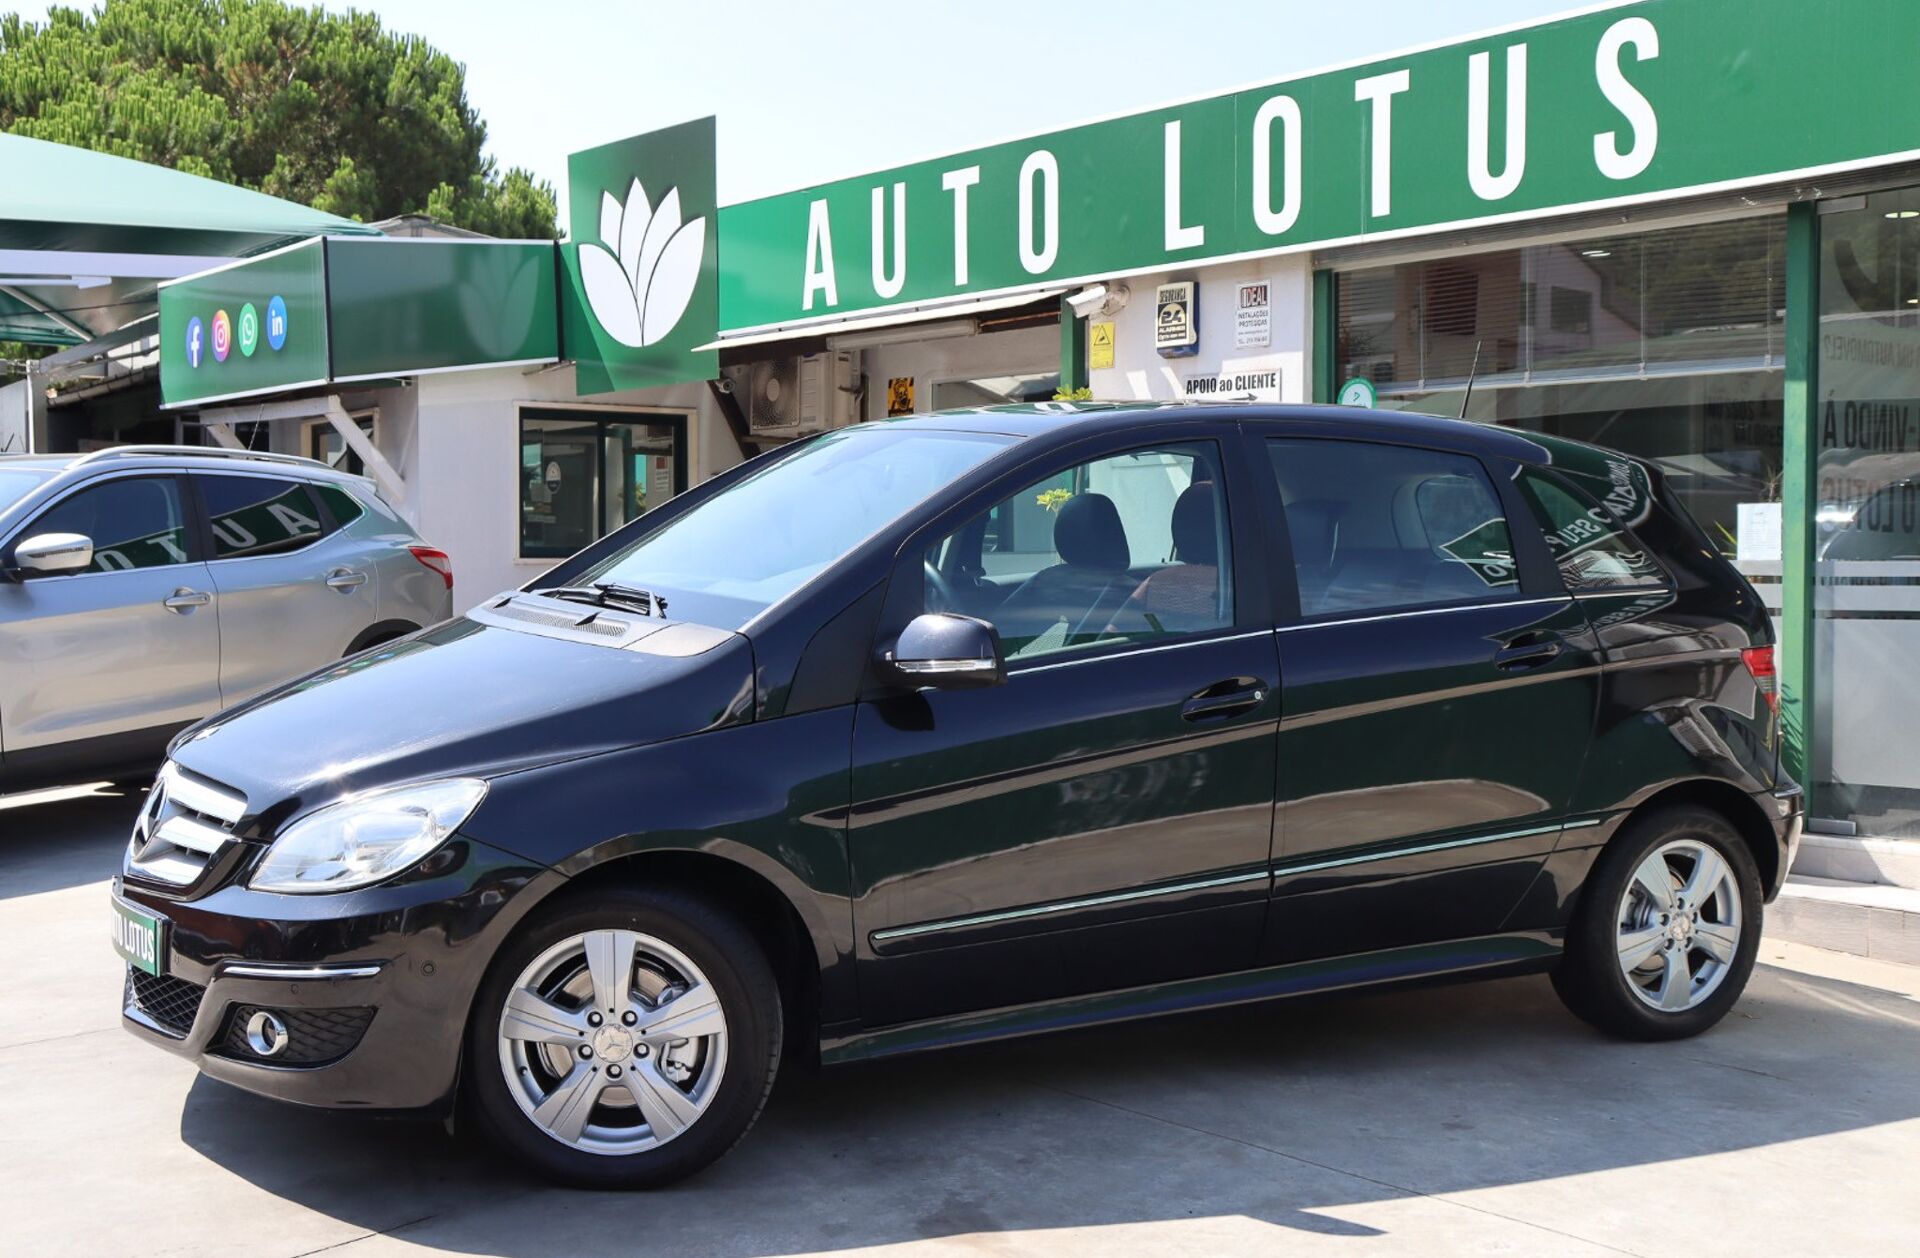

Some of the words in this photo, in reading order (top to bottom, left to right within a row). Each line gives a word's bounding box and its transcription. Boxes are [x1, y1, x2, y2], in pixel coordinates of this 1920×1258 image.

[802, 150, 1059, 311] AUTO
[1165, 17, 1659, 251] LOTUS
[1240, 285, 1268, 308] IDEAL
[1161, 310, 1183, 325] 24
[1186, 377, 1217, 394] APOIO
[1219, 379, 1232, 392] ao
[1235, 372, 1276, 391] CLIENTE
[124, 916, 154, 964] LOTUS
